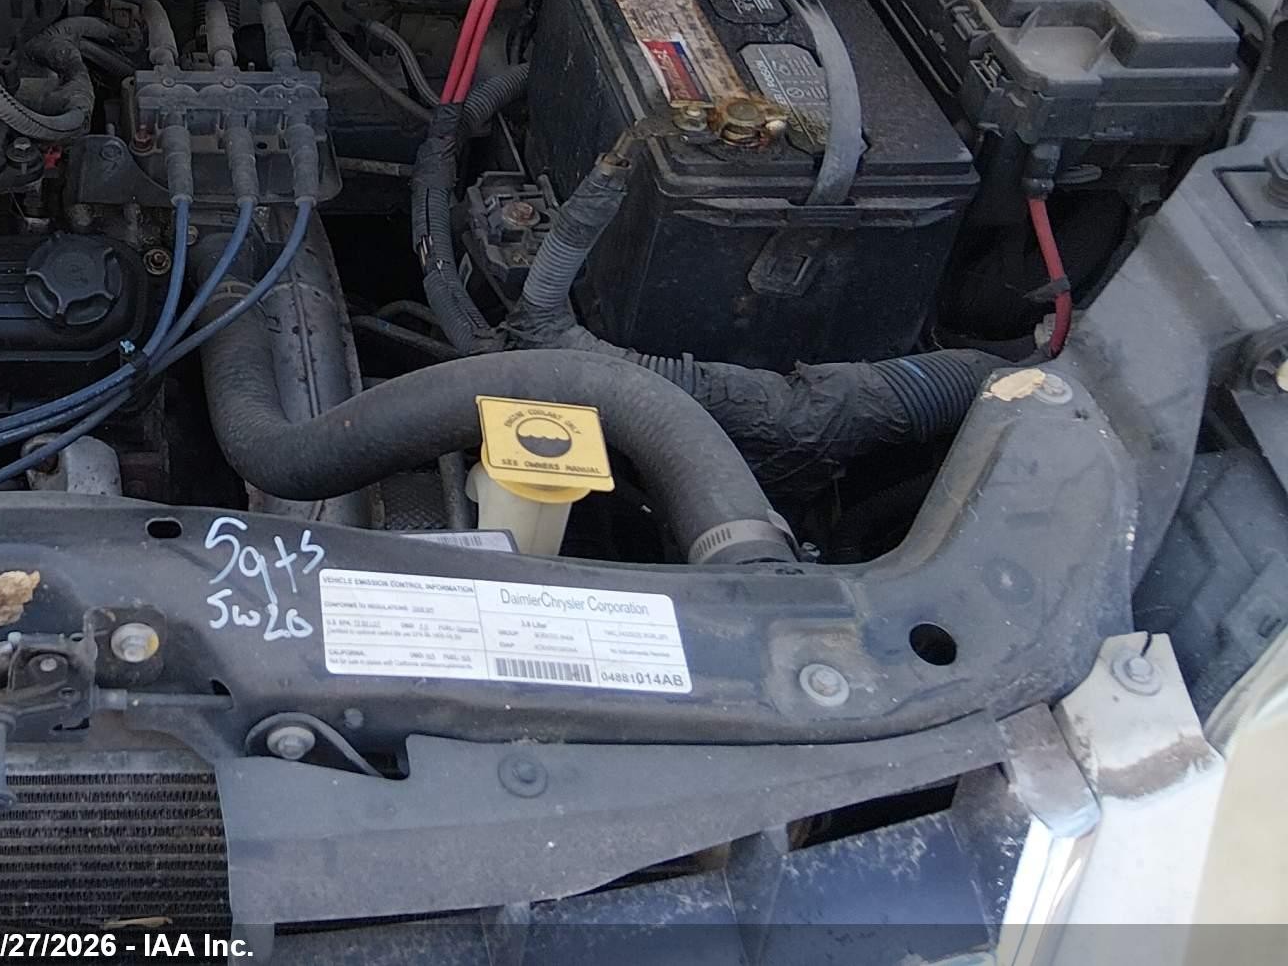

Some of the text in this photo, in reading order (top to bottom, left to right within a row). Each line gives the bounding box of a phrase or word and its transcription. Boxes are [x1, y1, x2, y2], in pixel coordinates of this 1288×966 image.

[527, 408, 563, 420] COOLANT
[564, 419, 582, 435] ONLY
[501, 458, 602, 474] SEE OWNERS MANUAL
[322, 575, 474, 594] VEHICLE EMISSION CONTROL INFORMATION
[500, 588, 650, 616] DaimlerChrysler Corporation
[601, 671, 685, 687] 04881014AB
